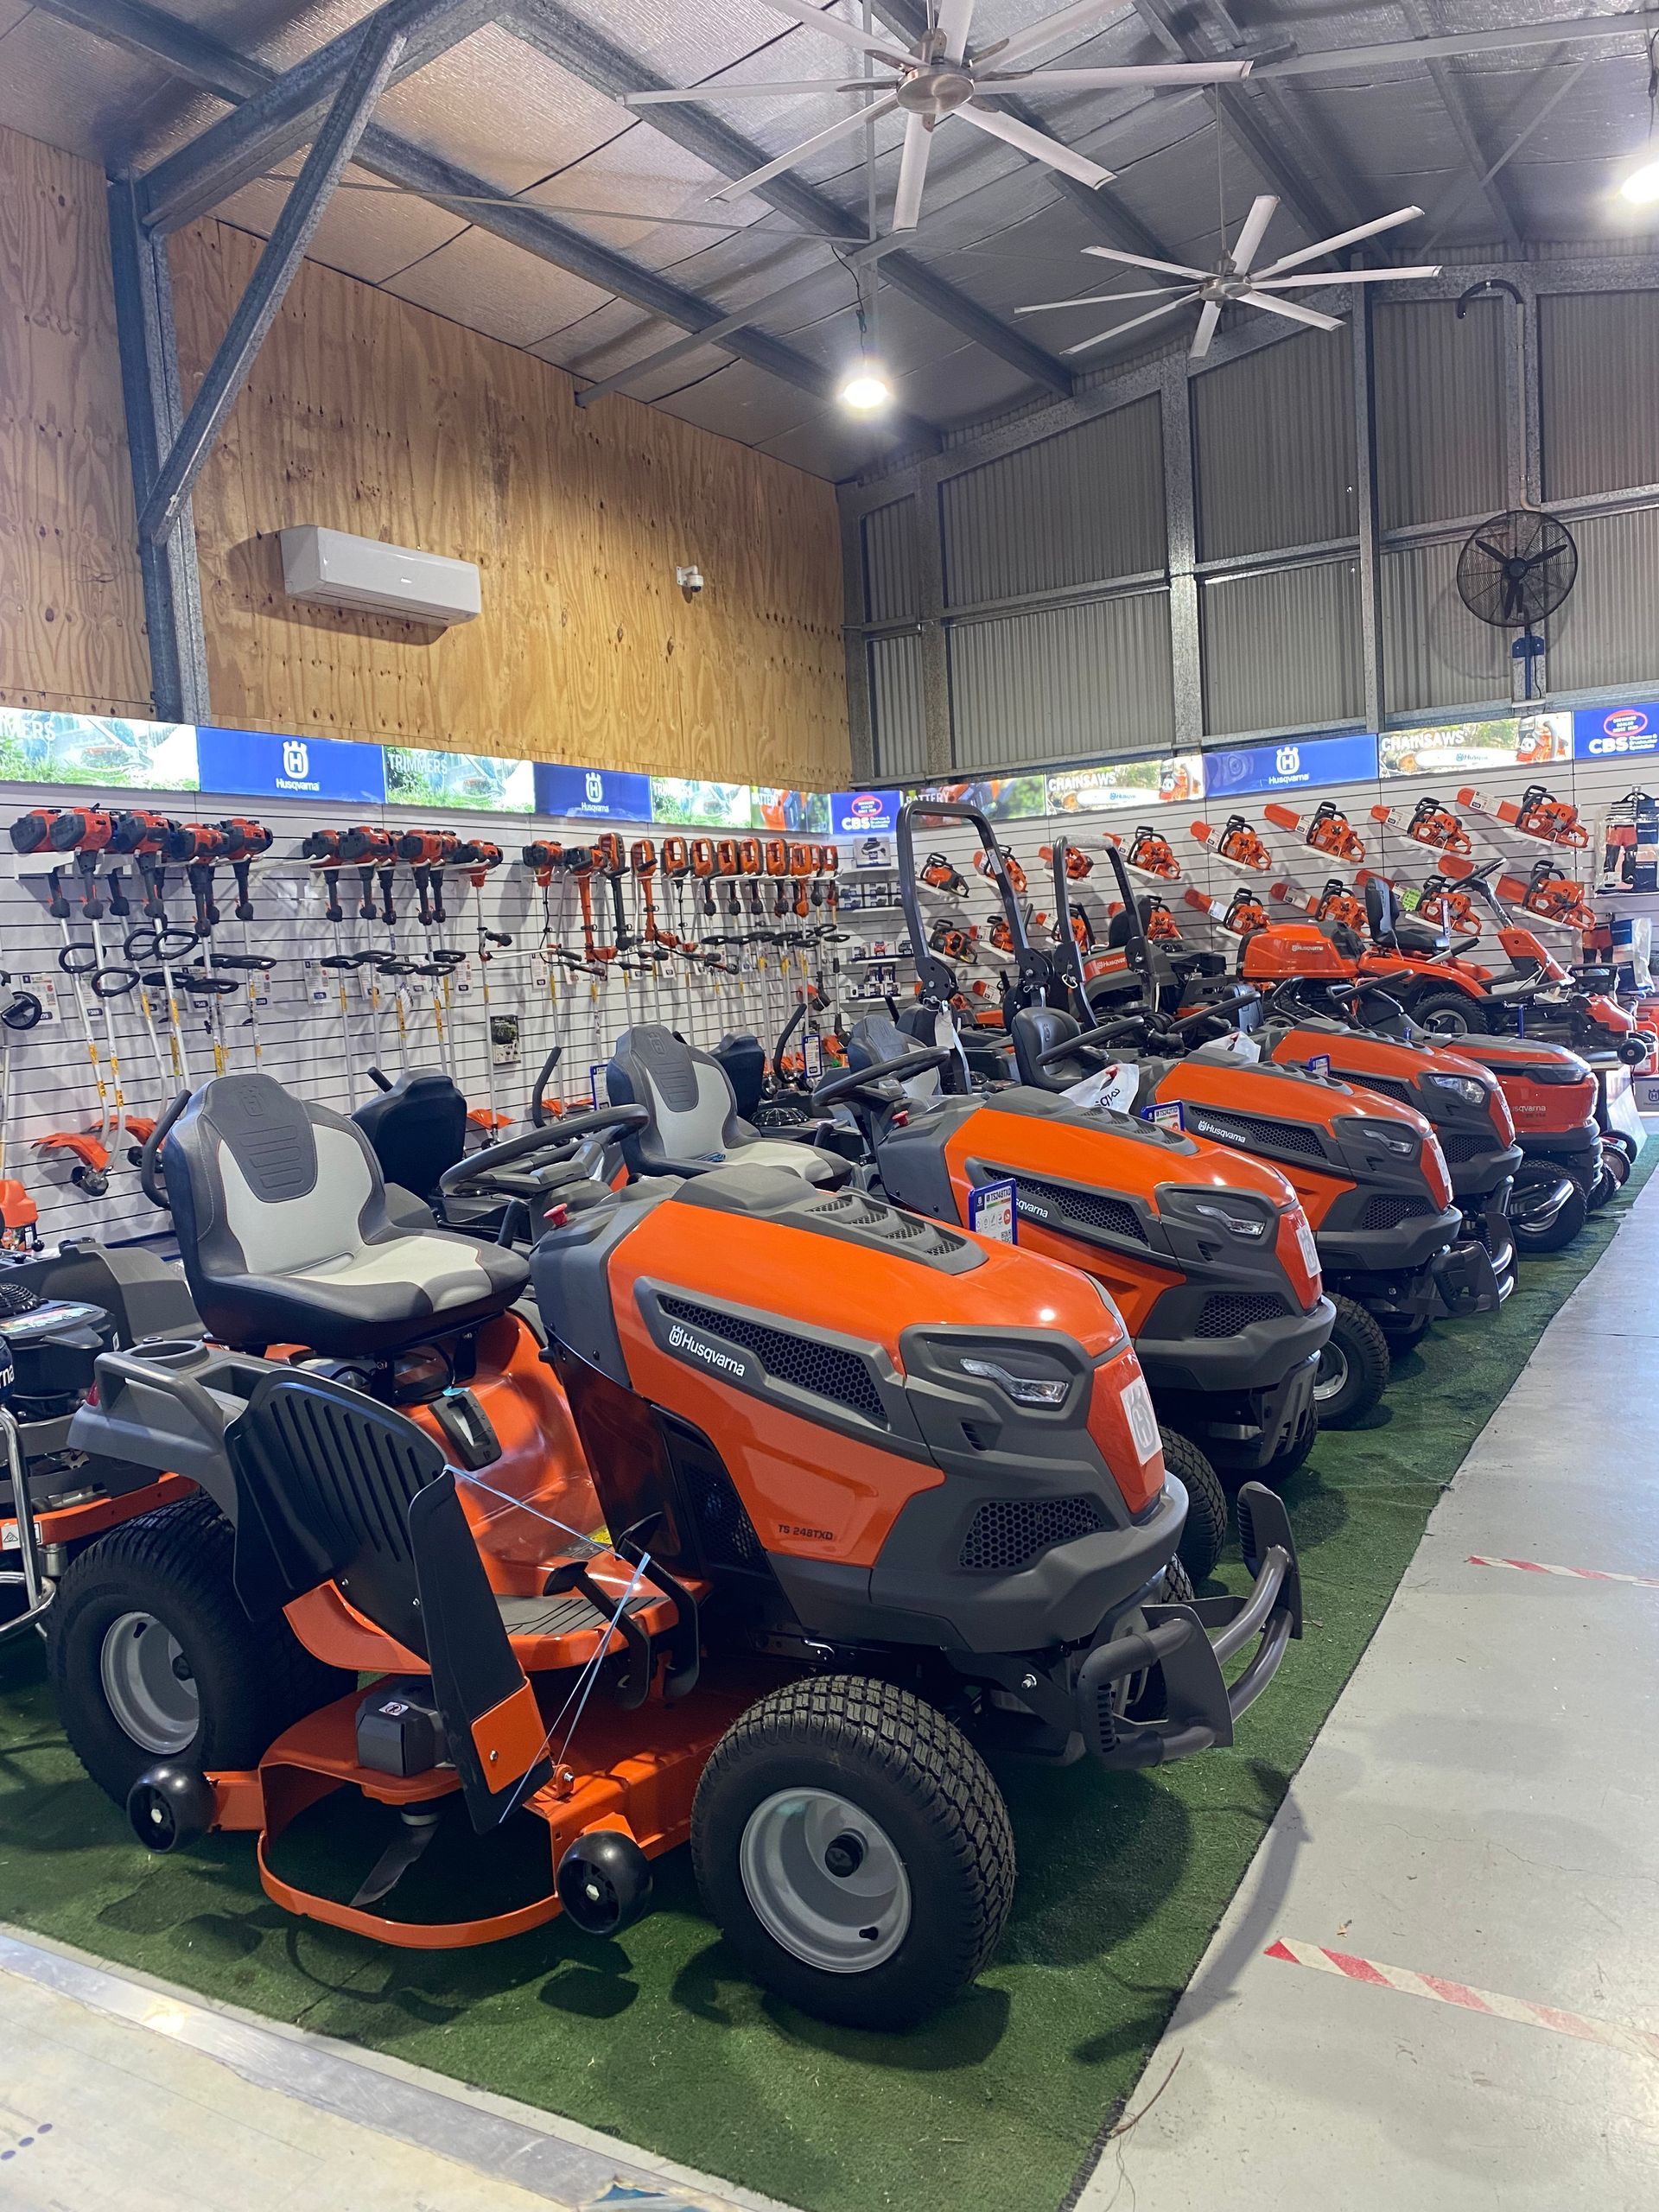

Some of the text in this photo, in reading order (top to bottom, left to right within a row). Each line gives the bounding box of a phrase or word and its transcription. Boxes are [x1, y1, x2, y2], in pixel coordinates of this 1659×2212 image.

[1382, 729, 1465, 752] CHAINSAWS
[1589, 737, 1629, 754] CBS
[388, 753, 448, 775] TRIMMERS
[276, 778, 320, 791] Husqvarna
[1048, 772, 1117, 791] CHAINSAWS
[1268, 774, 1309, 785] Husqvarna
[582, 802, 609, 812] Husqvarna
[842, 817, 871, 830] CBS
[1205, 1124, 1246, 1143] Husqvarna
[681, 1332, 746, 1377] Husqvarna
[779, 1524, 834, 1541] TS 248TXD
